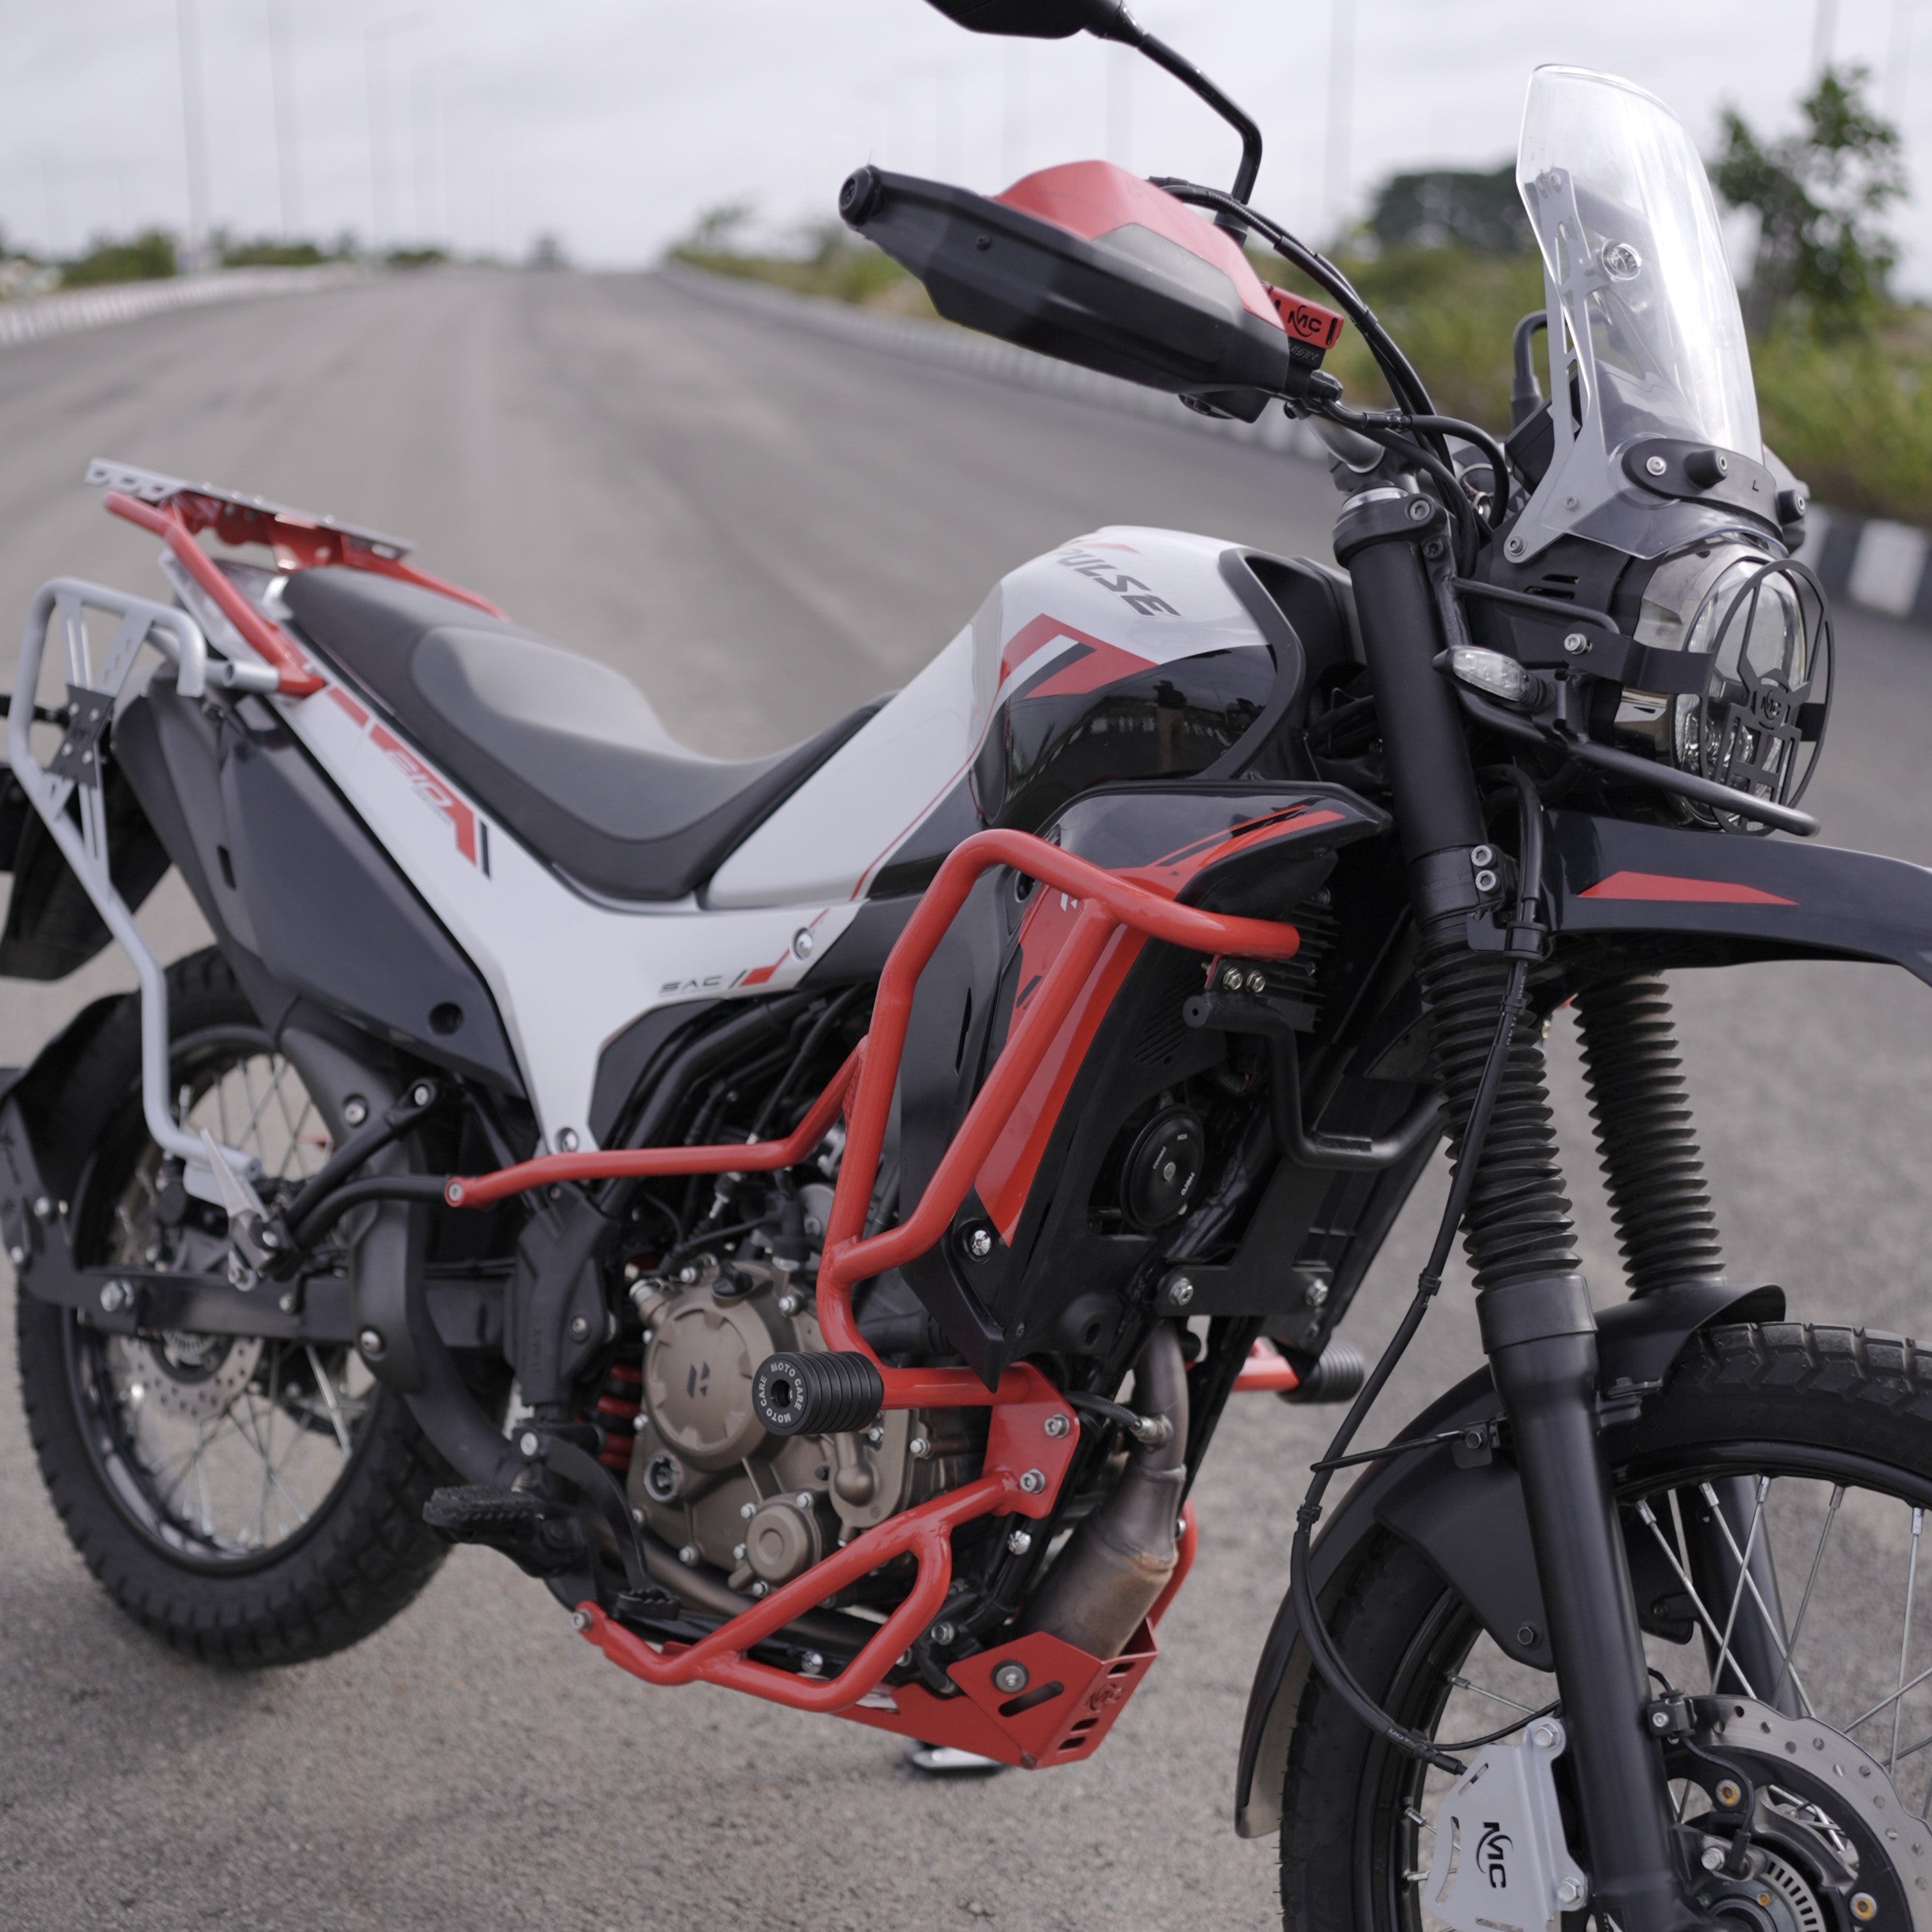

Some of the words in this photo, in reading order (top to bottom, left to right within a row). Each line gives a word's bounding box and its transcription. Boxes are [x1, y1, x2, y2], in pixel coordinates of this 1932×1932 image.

[759, 1375, 768, 1407] CARE
[770, 1362, 796, 1377] MOTO
[794, 1379, 804, 1411] CARE
[766, 1408, 792, 1423] MOTO
